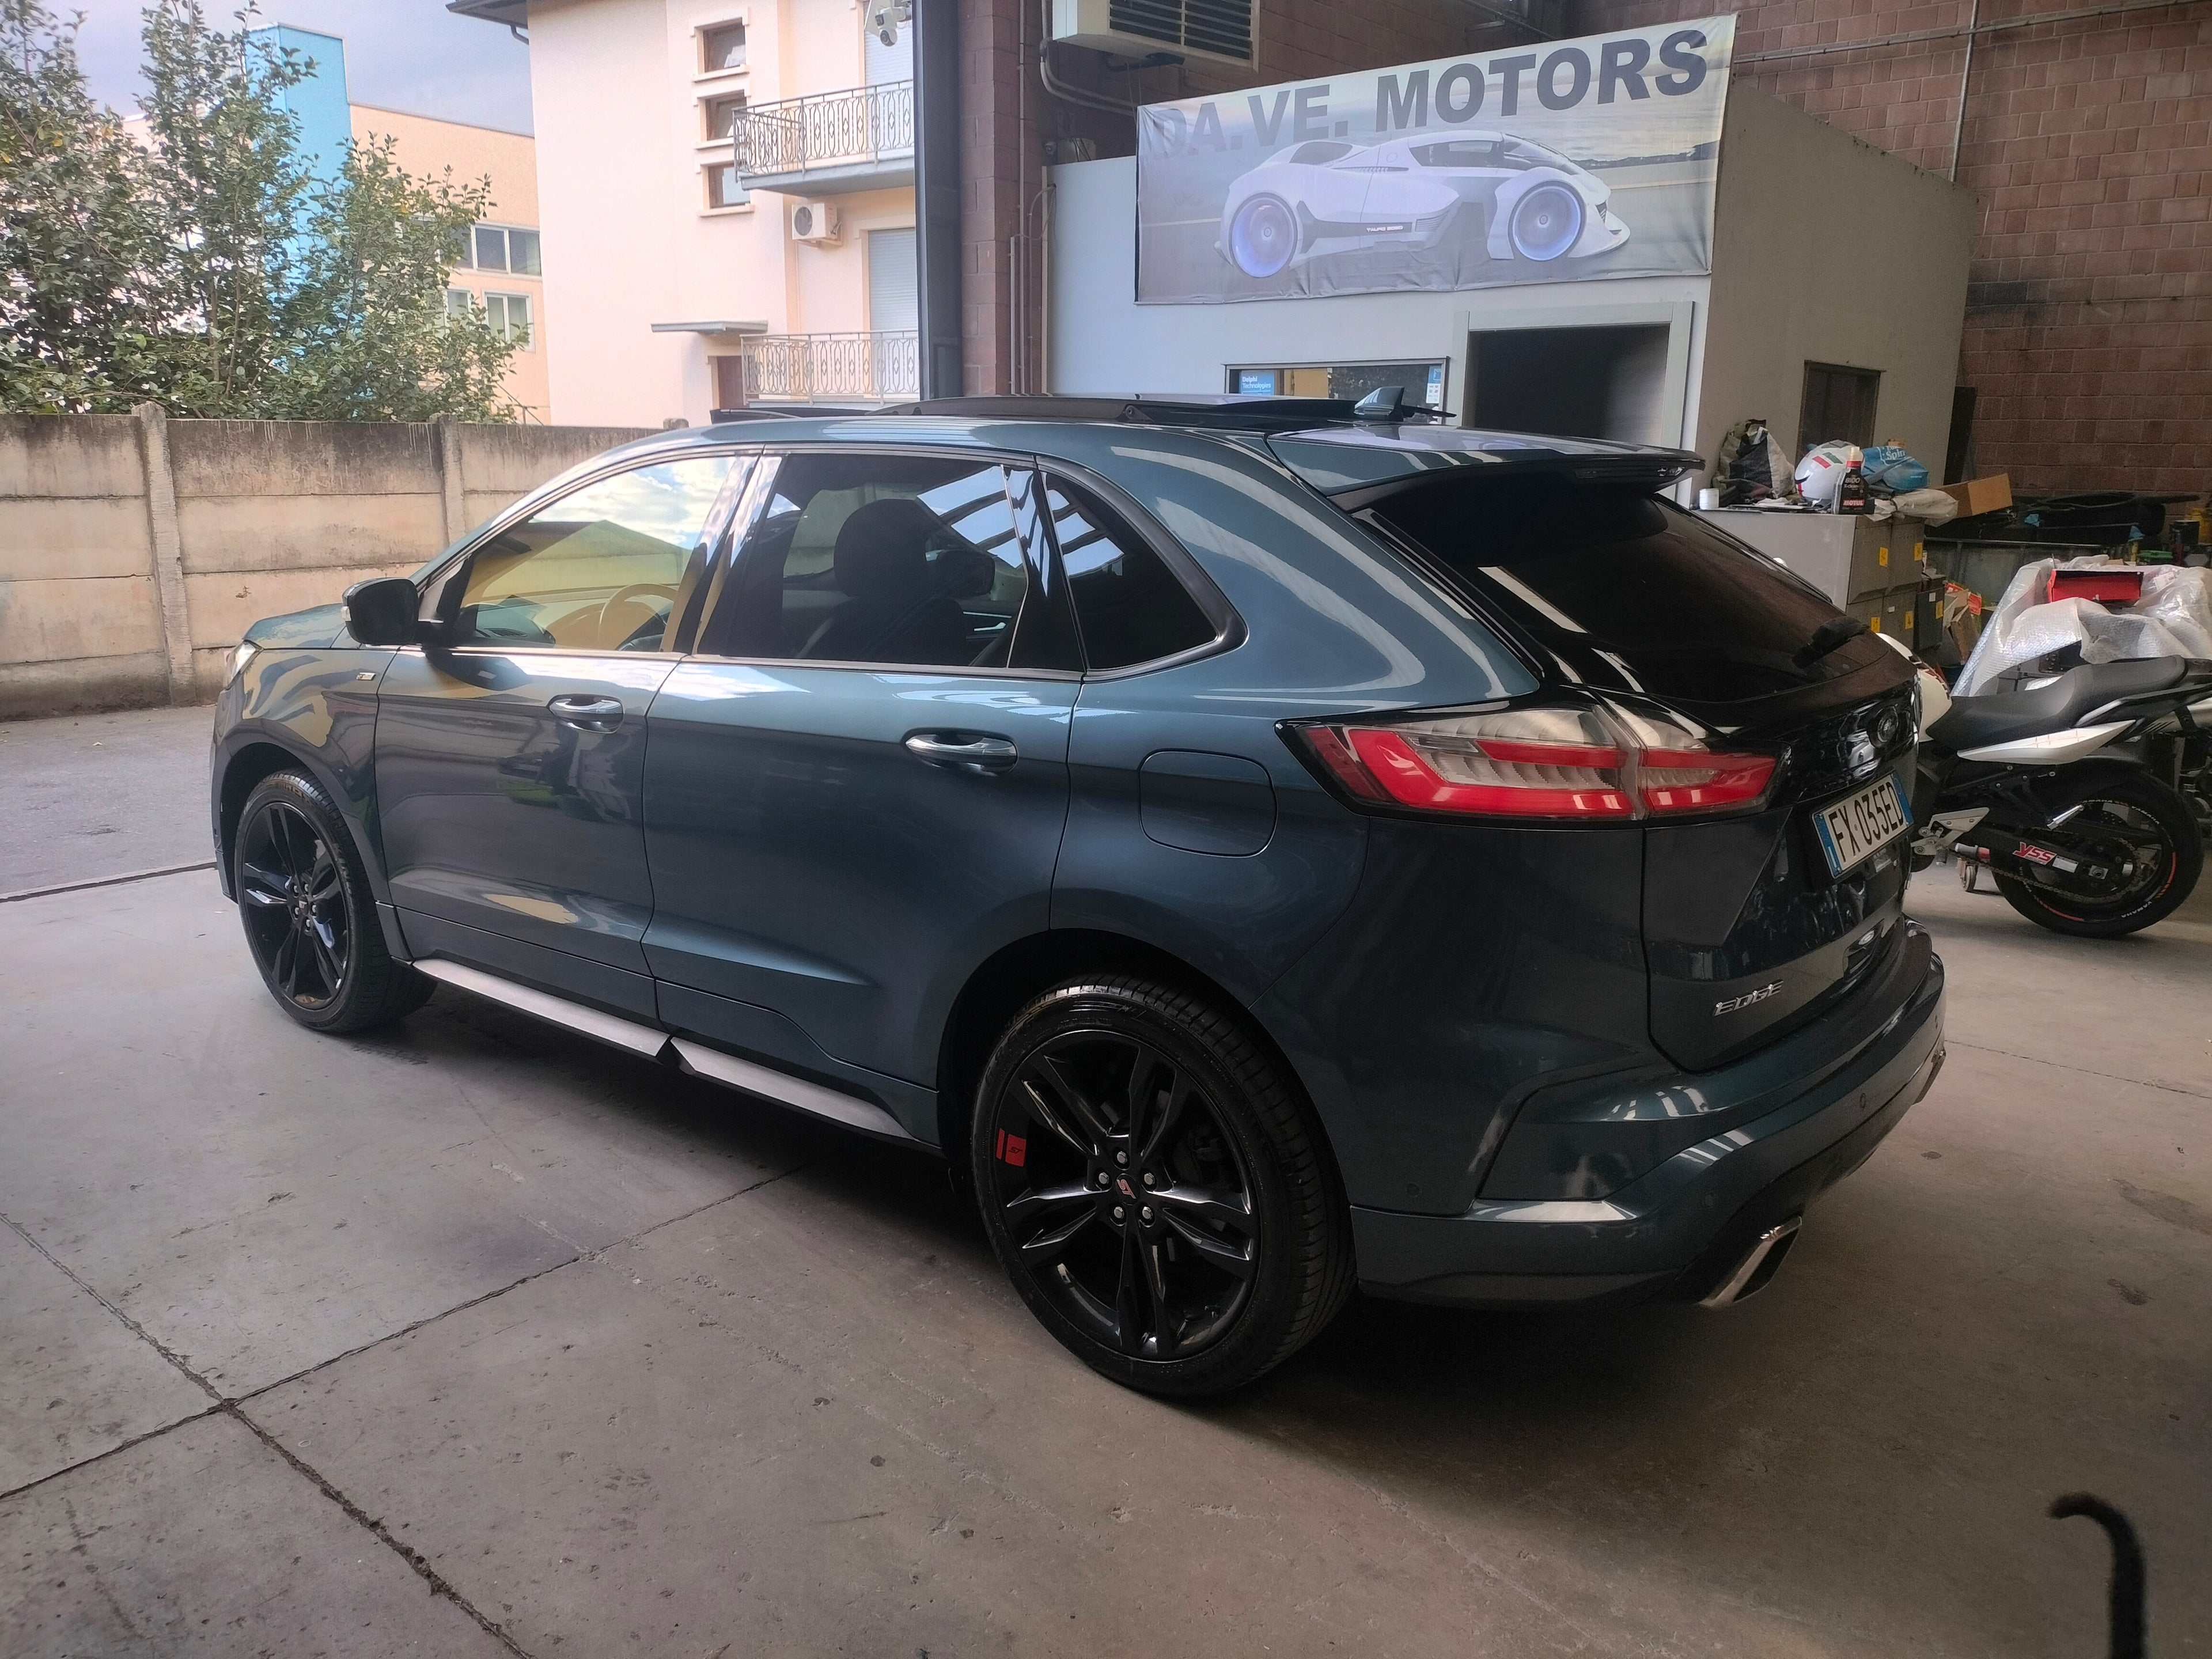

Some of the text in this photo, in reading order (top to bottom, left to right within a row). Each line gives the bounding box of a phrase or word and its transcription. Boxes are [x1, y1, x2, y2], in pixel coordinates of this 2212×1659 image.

[1376, 29, 1709, 133] MOTORS
[1243, 382, 1271, 391] Technologies
[1828, 781, 1904, 863] FX 035ED
[2013, 842, 2056, 863] YSS
[1713, 980, 1783, 1017] EDGE
[1116, 1179, 1137, 1199] ST
